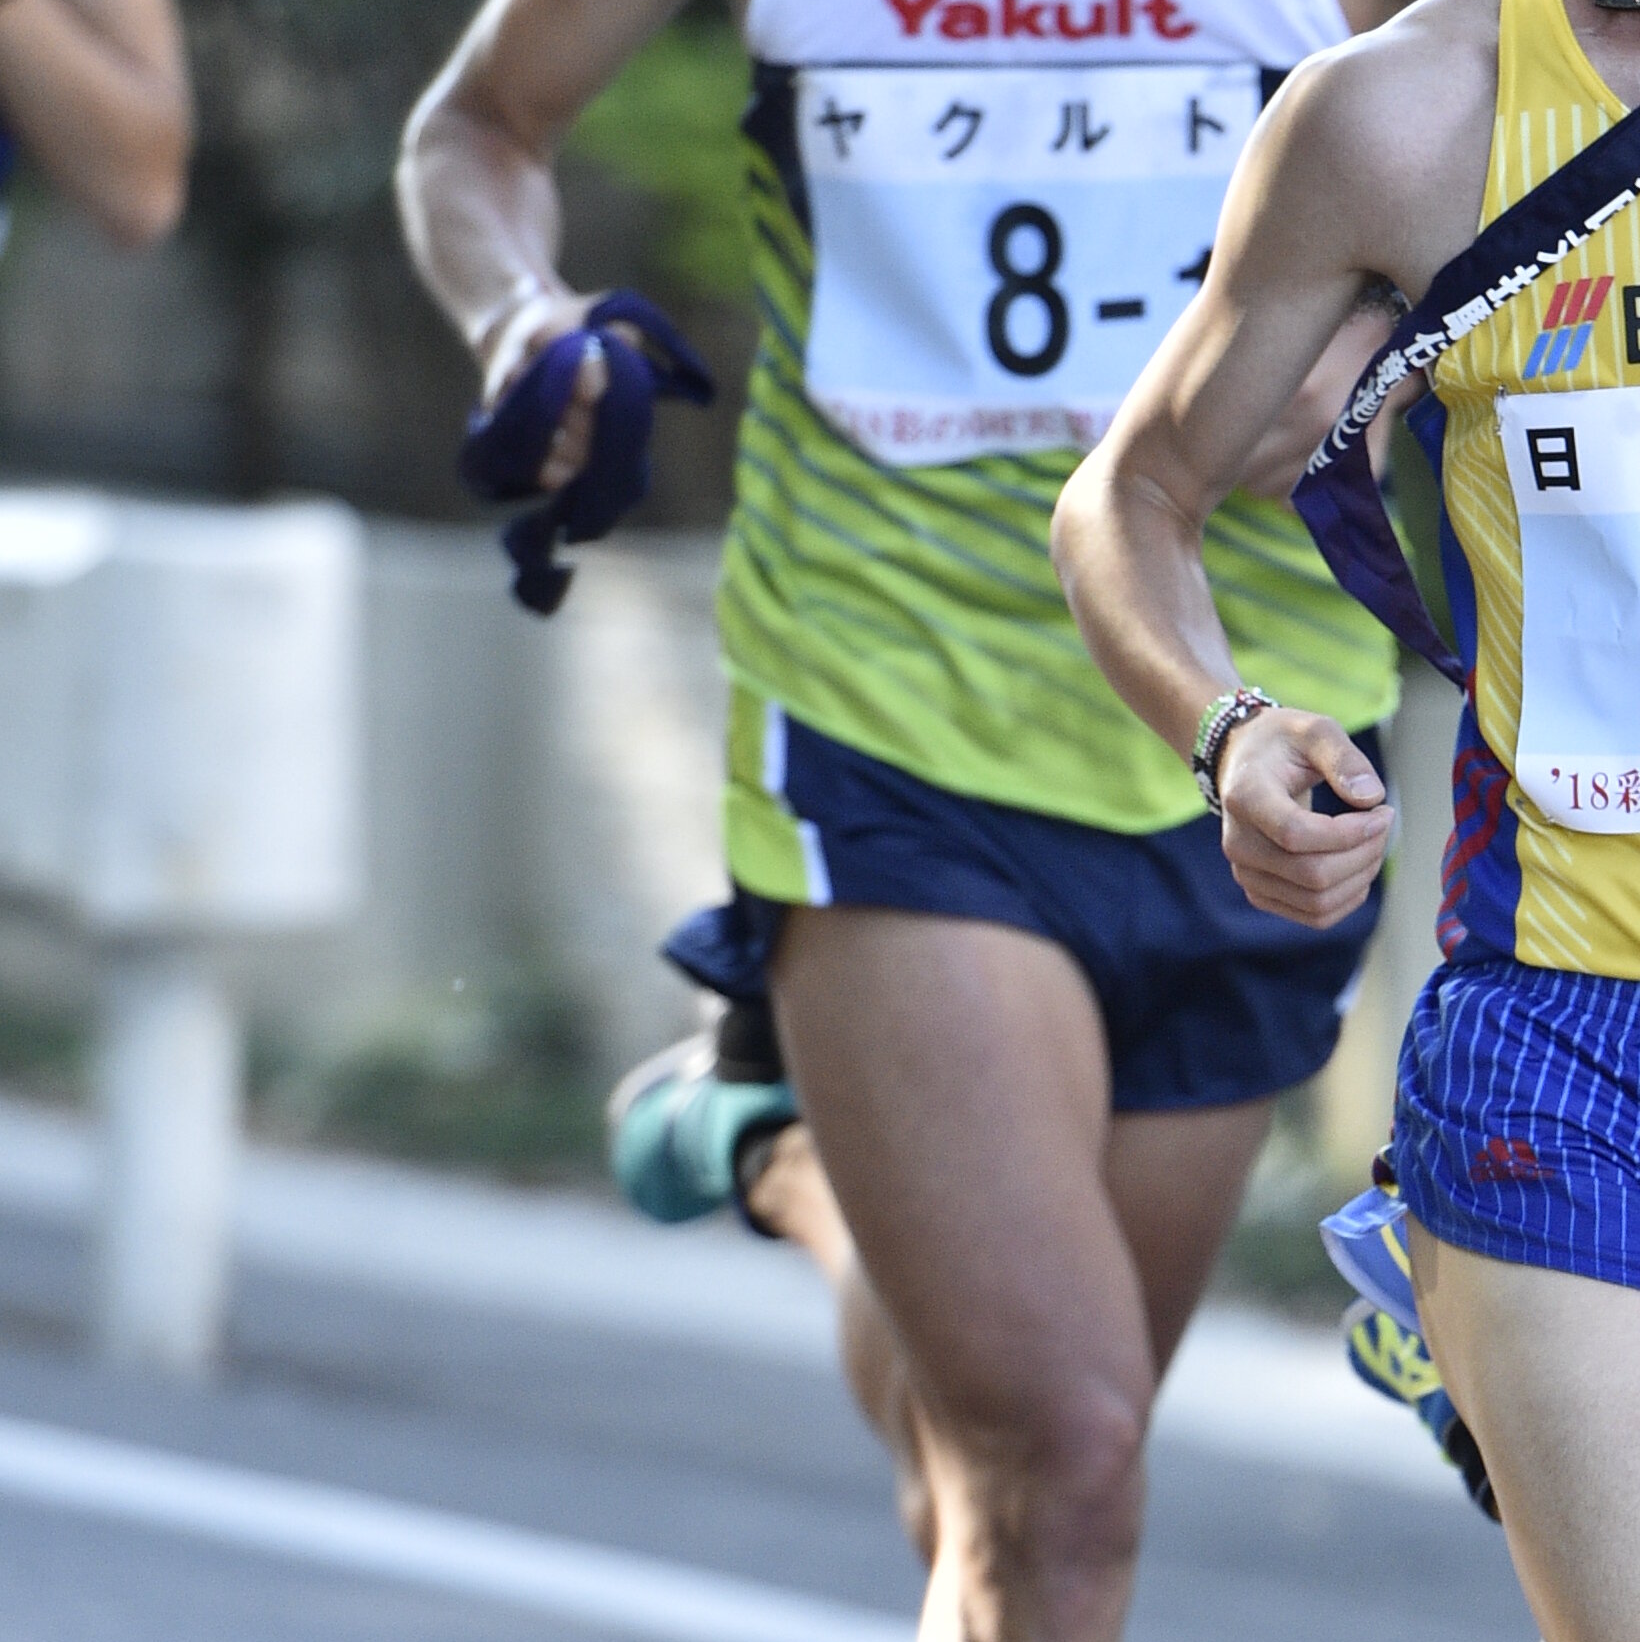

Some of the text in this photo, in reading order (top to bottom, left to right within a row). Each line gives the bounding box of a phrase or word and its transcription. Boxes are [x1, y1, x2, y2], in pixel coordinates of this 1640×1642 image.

[815, 95, 1225, 159] ヤクルト
[986, 202, 1213, 378] 8-
